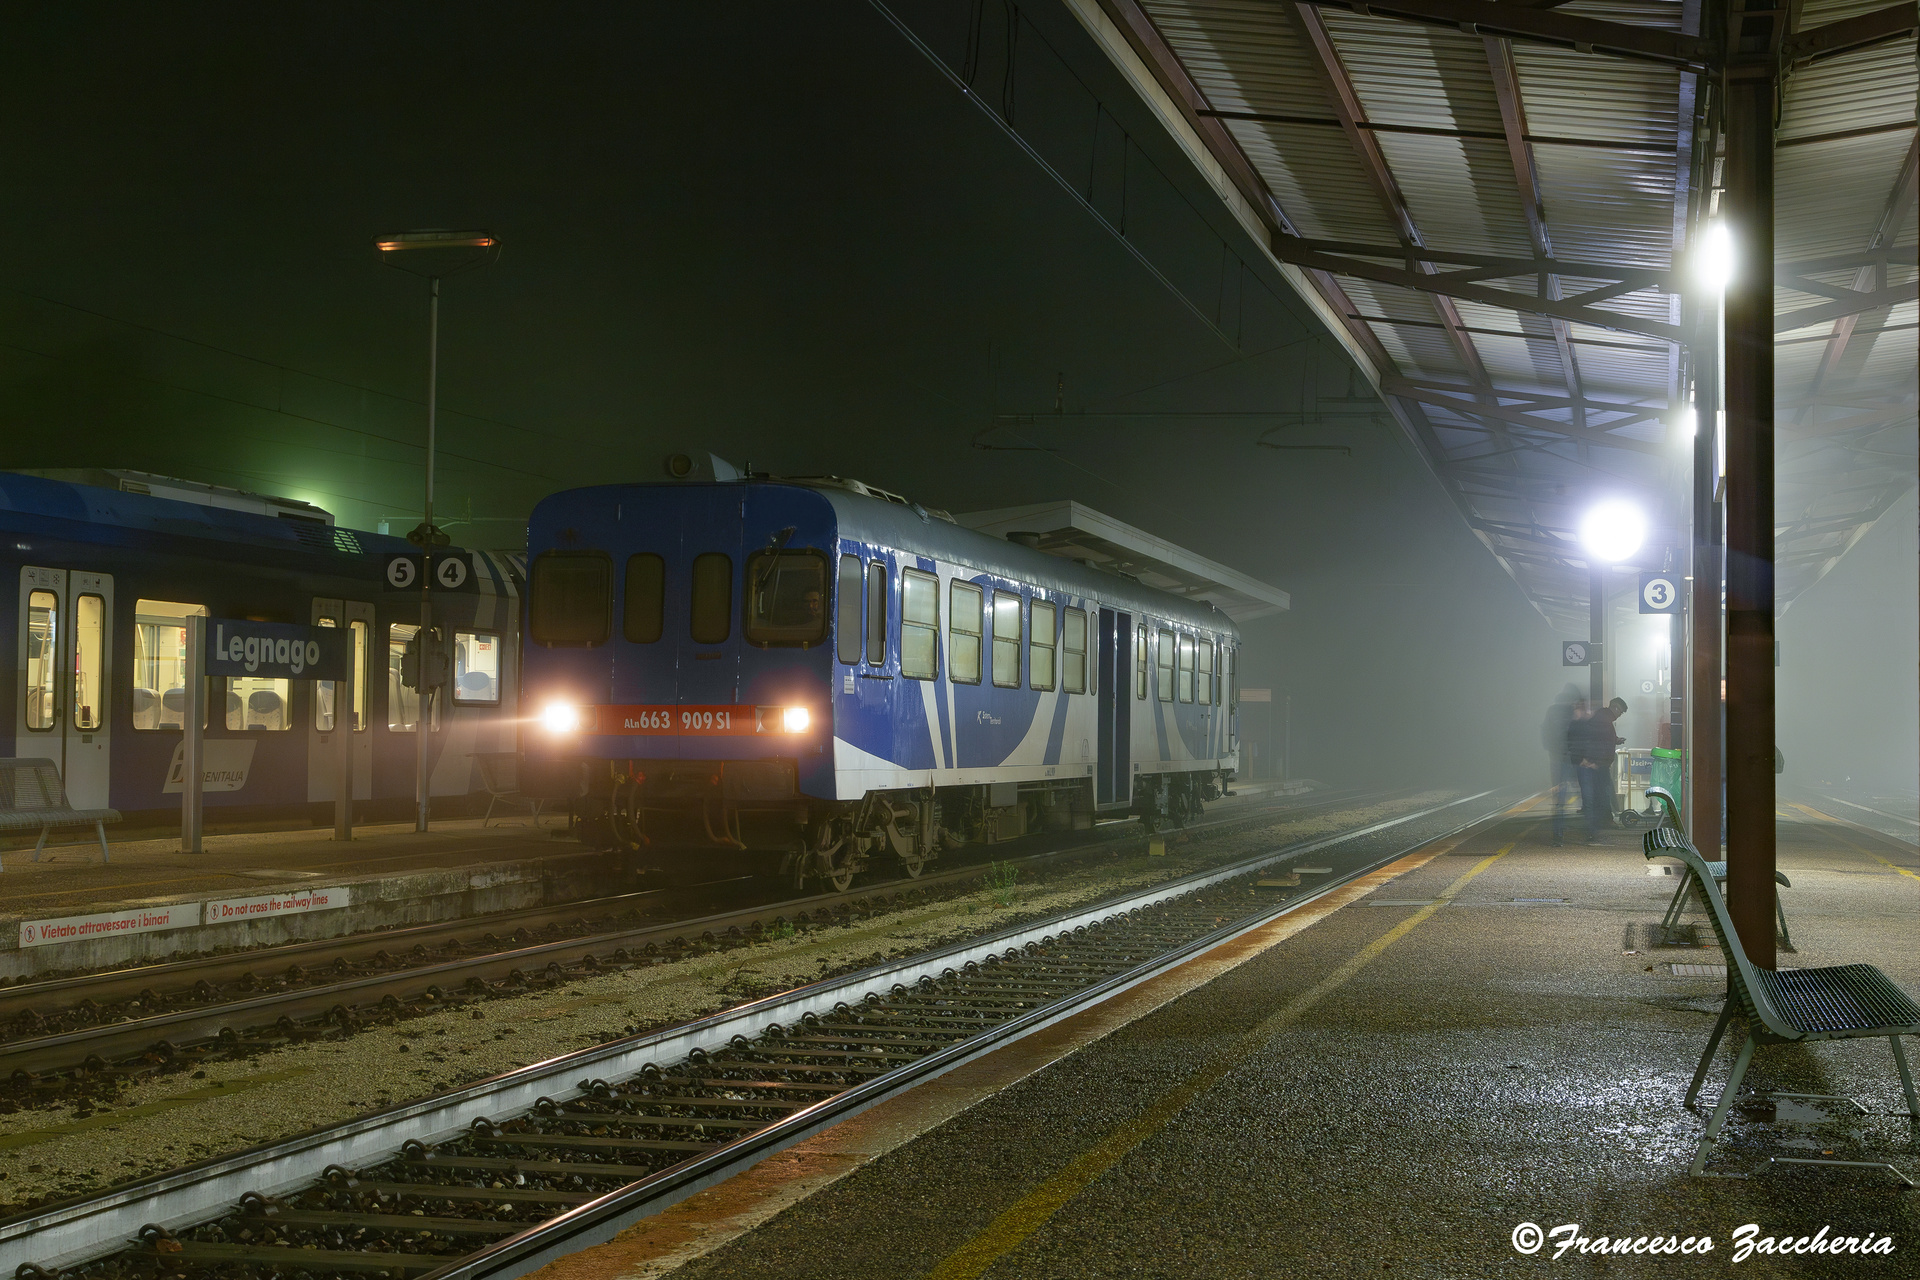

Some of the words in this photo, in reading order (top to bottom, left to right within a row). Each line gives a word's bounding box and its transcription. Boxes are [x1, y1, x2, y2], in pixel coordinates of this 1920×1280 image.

[394, 562, 408, 583] 5
[442, 562, 459, 583] 4
[1651, 583, 1668, 604] 3
[216, 623, 320, 674] Legnago
[201, 770, 244, 783] RENITALIA
[222, 904, 234, 917] Do
[235, 903, 248, 915] not
[249, 903, 268, 914] cross
[269, 898, 282, 911] the
[283, 896, 311, 910] railway
[312, 893, 328, 906] lines
[40, 924, 77, 939] Vietato
[79, 918, 136, 935] attraversare
[143, 911, 170, 927] binari
